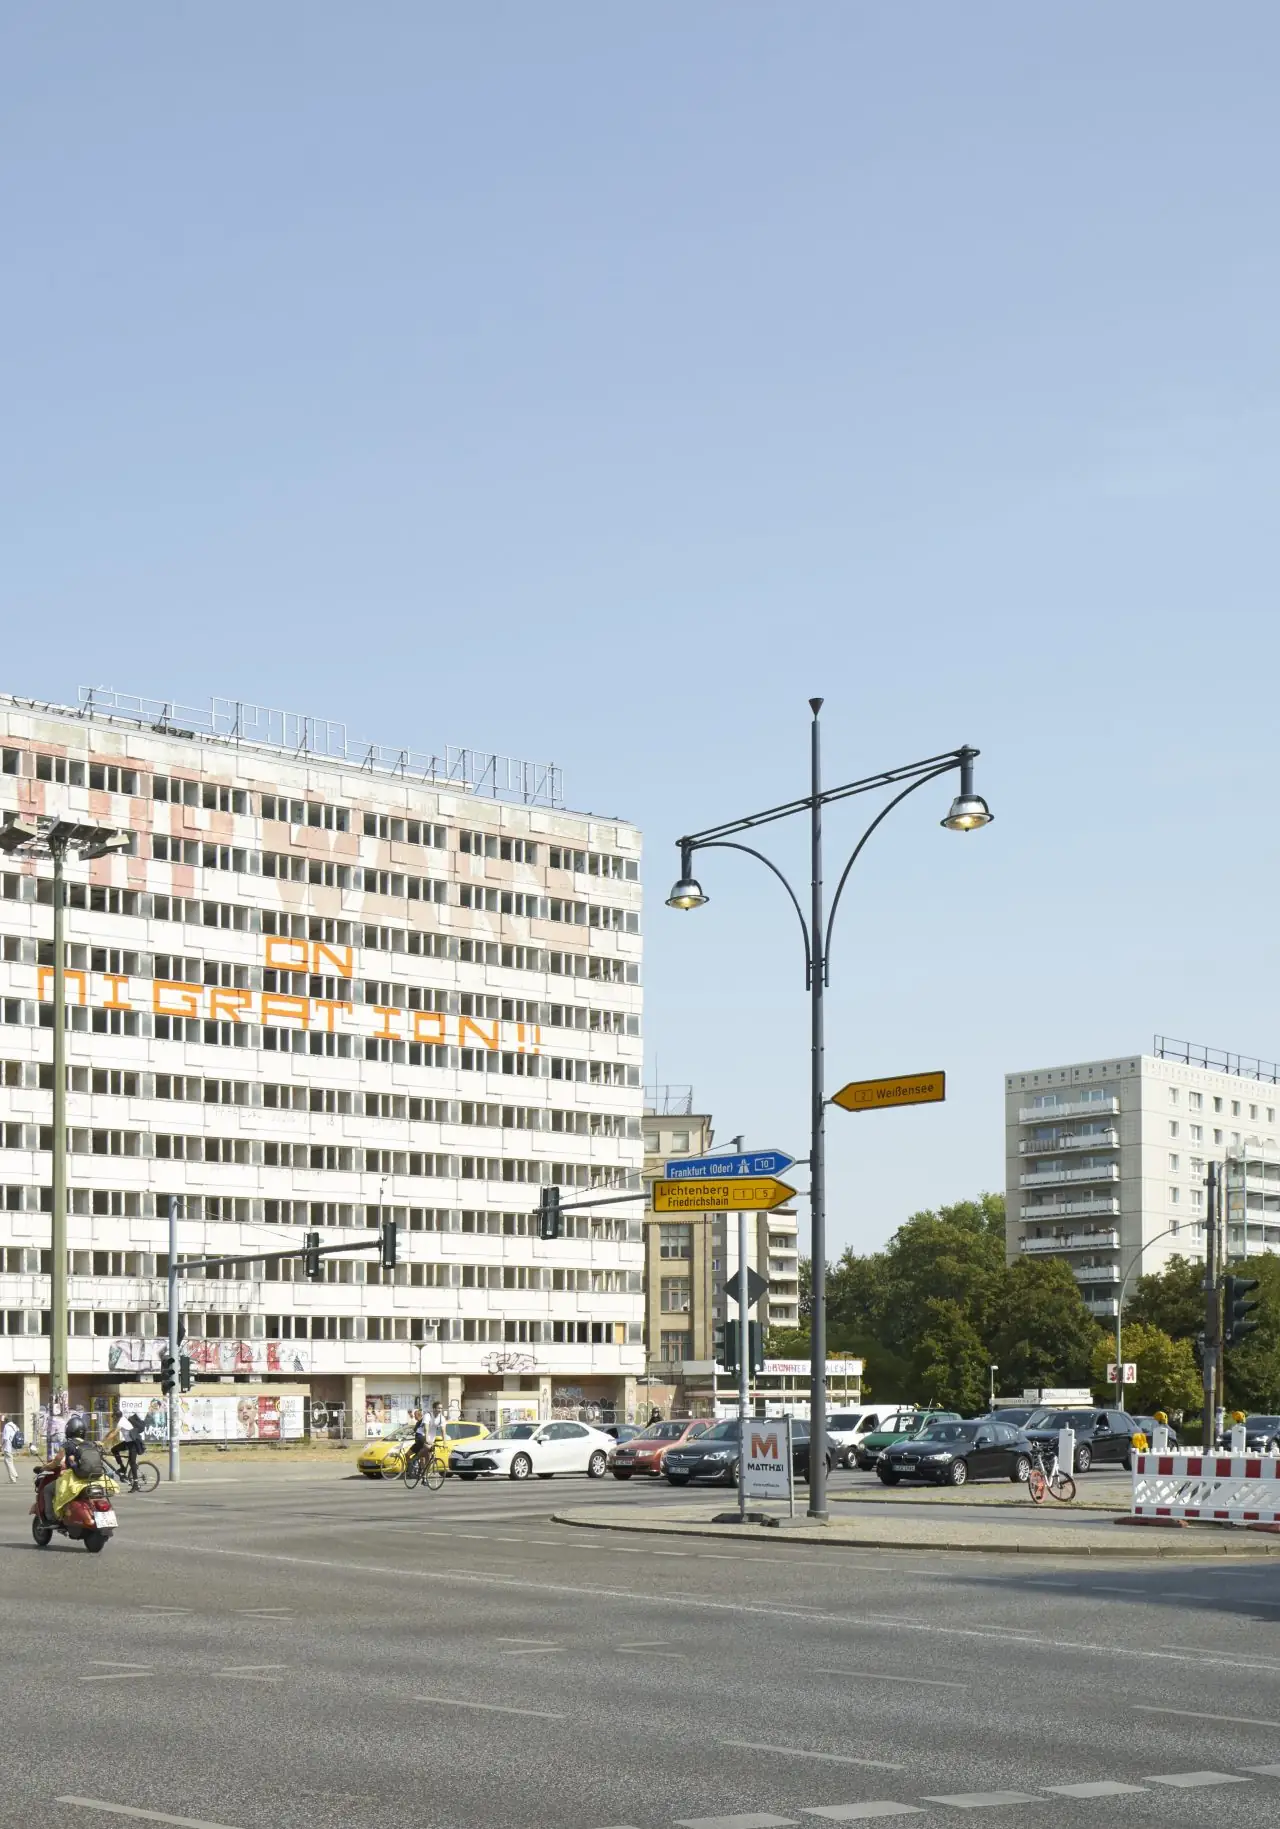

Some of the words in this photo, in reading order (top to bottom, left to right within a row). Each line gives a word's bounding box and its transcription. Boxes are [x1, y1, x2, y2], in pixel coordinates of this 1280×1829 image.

[266, 936, 353, 978] ON
[876, 1083, 935, 1099] Weißensee
[670, 1166, 706, 1178] Frankfurt
[710, 1163, 733, 1174] (Oder)
[760, 1160, 769, 1168] 10
[660, 1185, 729, 1196] Lichtenberg
[668, 1197, 729, 1207] Friedrichshain
[122, 1400, 143, 1408] Bread
[751, 1432, 779, 1460] M
